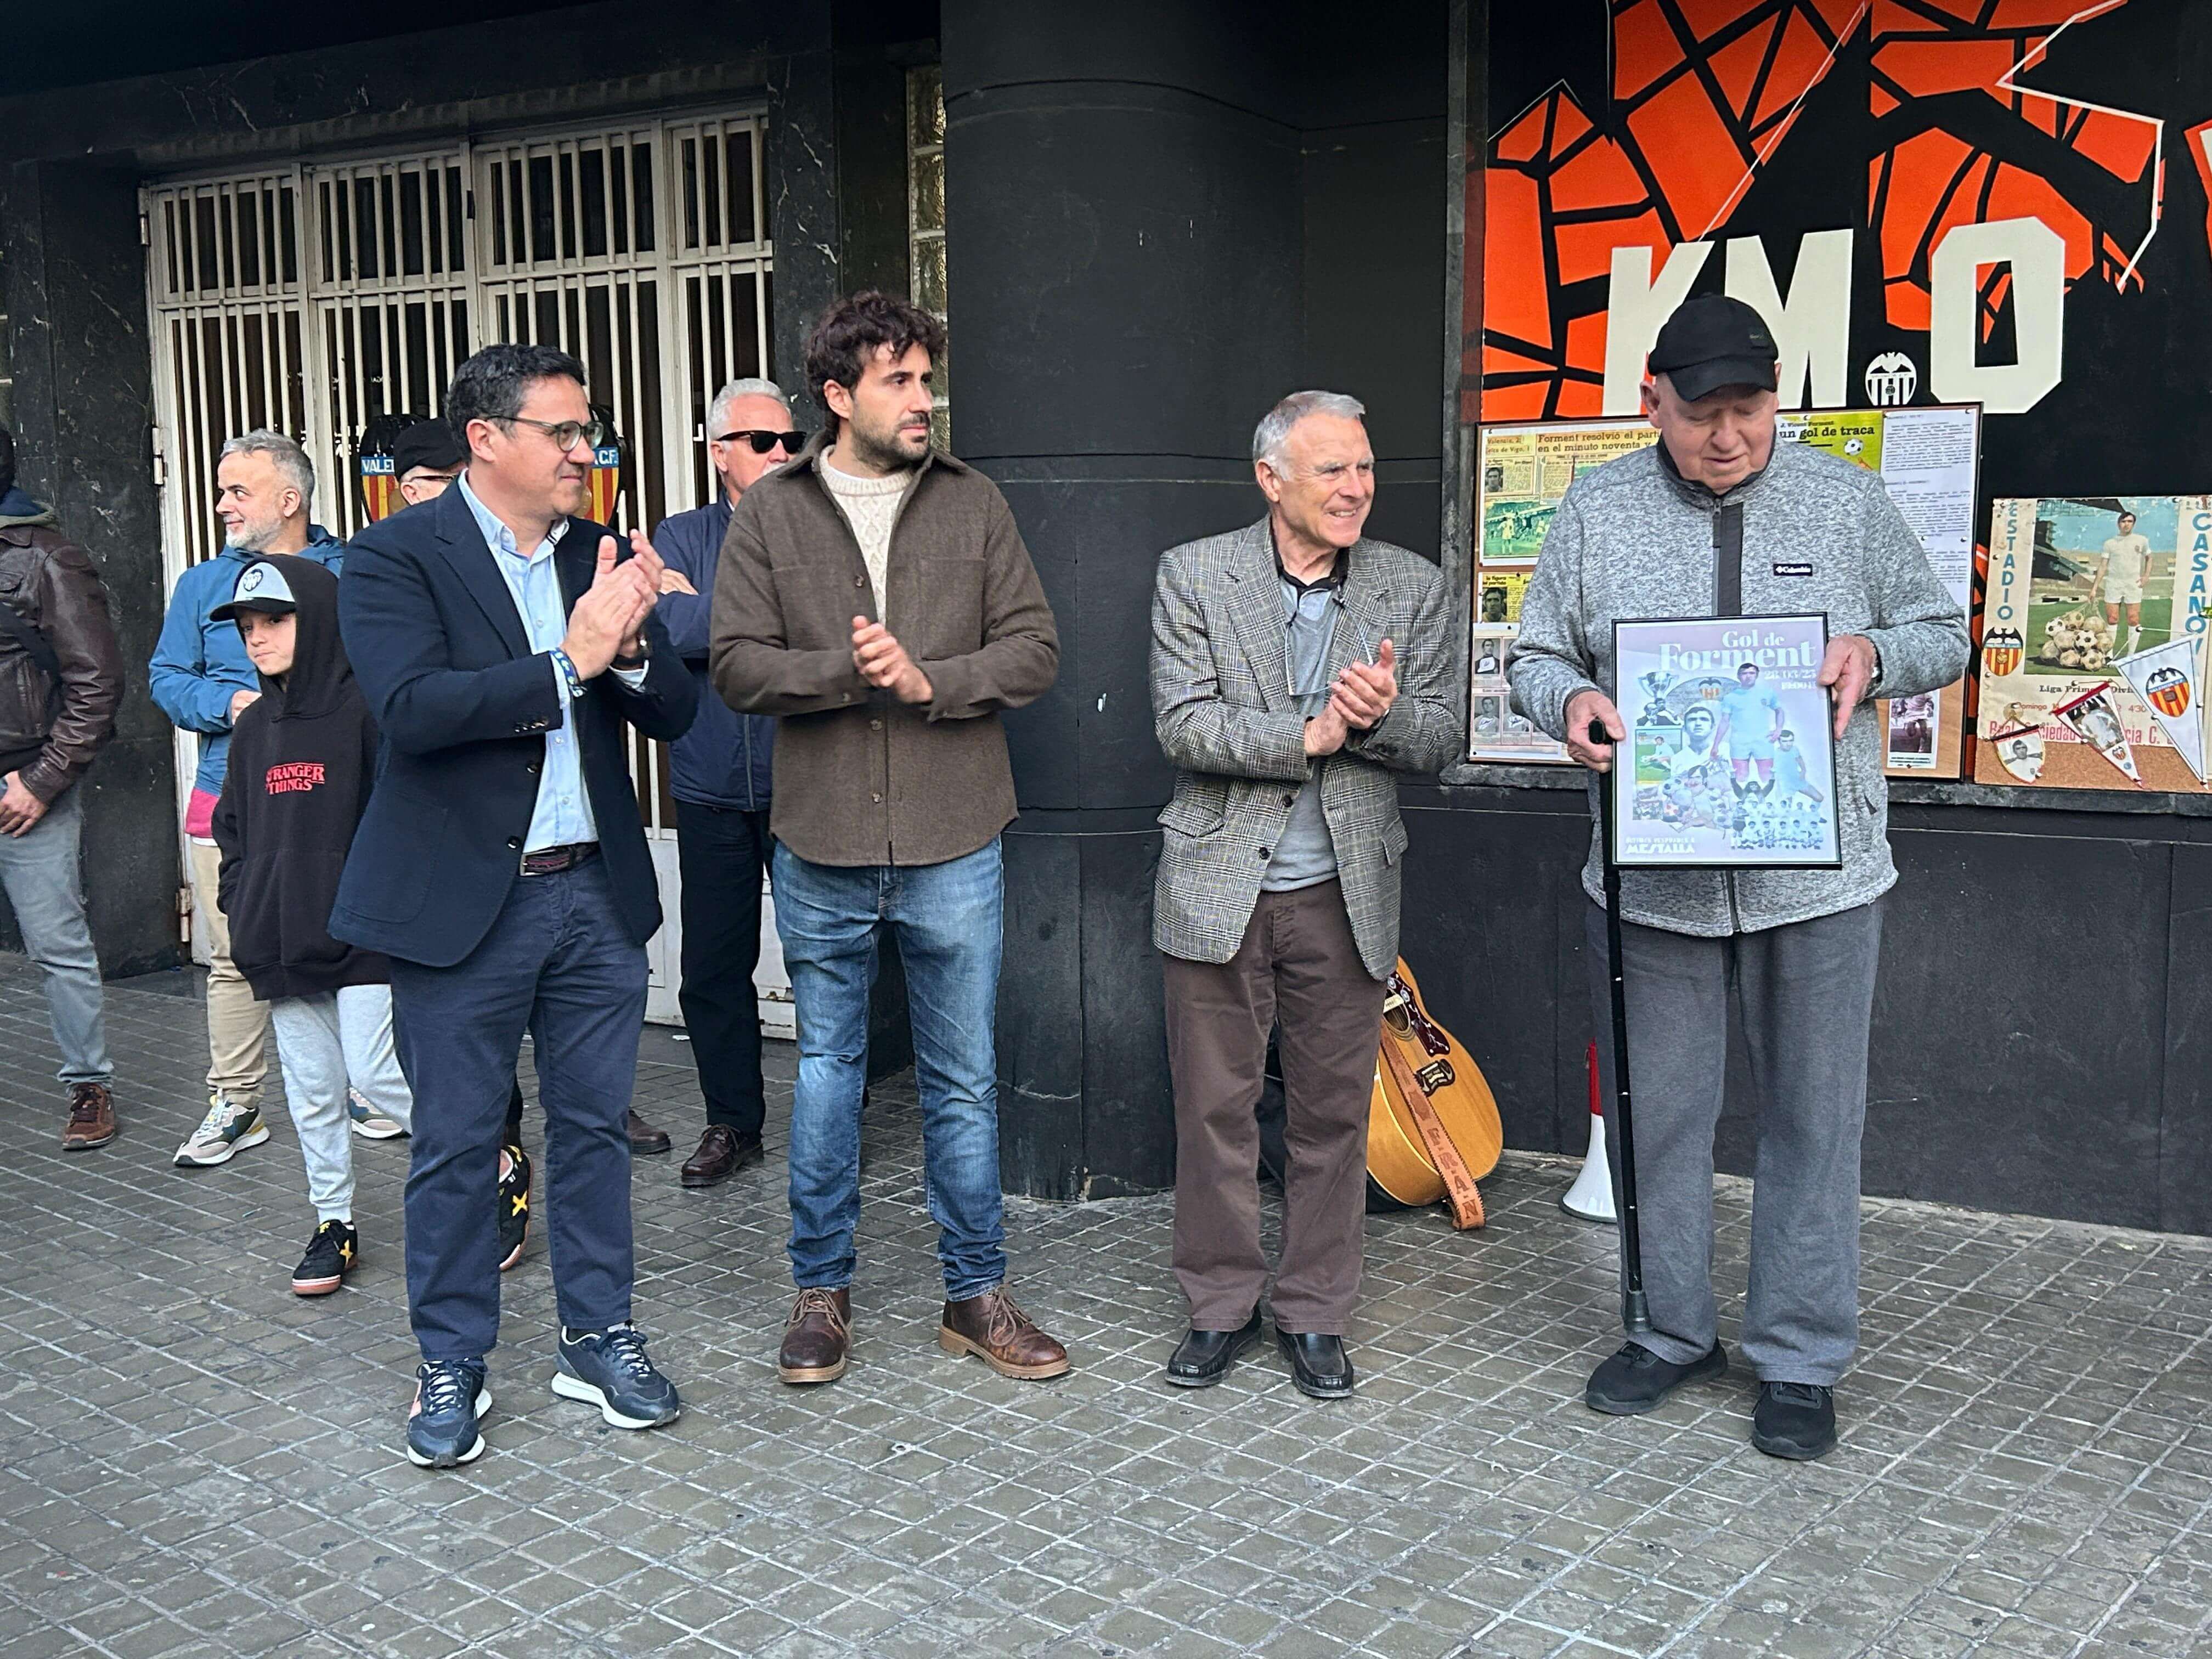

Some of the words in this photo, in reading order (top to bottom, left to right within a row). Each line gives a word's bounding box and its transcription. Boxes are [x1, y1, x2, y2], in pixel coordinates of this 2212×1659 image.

[1602, 229, 1854, 416] KM
[1538, 434, 1578, 443] Forment
[1583, 432, 1620, 441] resolvió
[1638, 431, 1660, 441] part
[1799, 428, 1818, 439] gol
[1821, 427, 1837, 436] de
[1841, 426, 1875, 436] traca
[1565, 443, 1599, 452] minuto
[1722, 629, 1759, 648] Gol
[1764, 632, 1785, 646] de
[1658, 640, 1817, 672] Forment
[268, 777, 312, 795] THINGS
